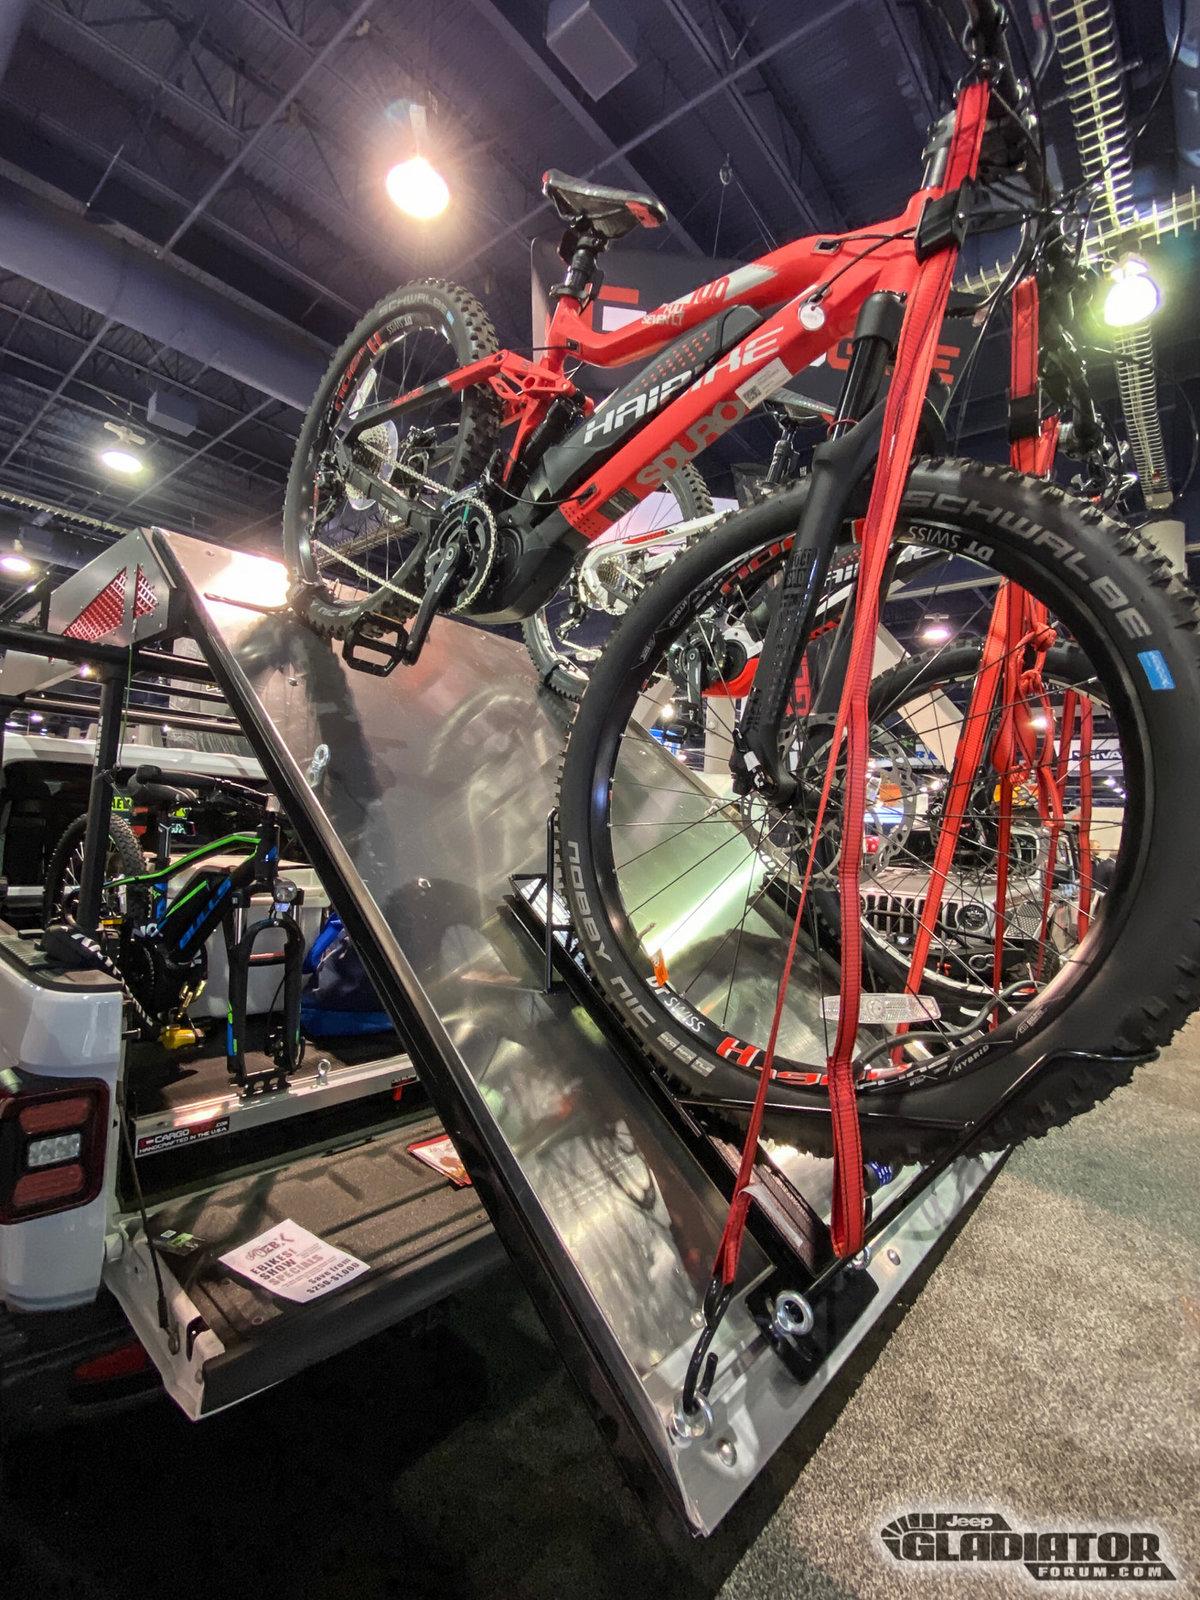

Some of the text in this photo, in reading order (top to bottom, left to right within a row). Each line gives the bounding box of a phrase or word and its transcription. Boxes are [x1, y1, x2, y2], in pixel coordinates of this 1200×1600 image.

[908, 525, 962, 548] SWISS
[903, 489, 1152, 640] SCHWALBE
[568, 840, 656, 1028] NOBBY NIC
[664, 996, 706, 1033] SWISS
[953, 1044, 989, 1073] HYBRID
[154, 1128, 190, 1144] CARGO
[259, 1258, 298, 1281] SHOW
[268, 1254, 325, 1286] SPECIALS
